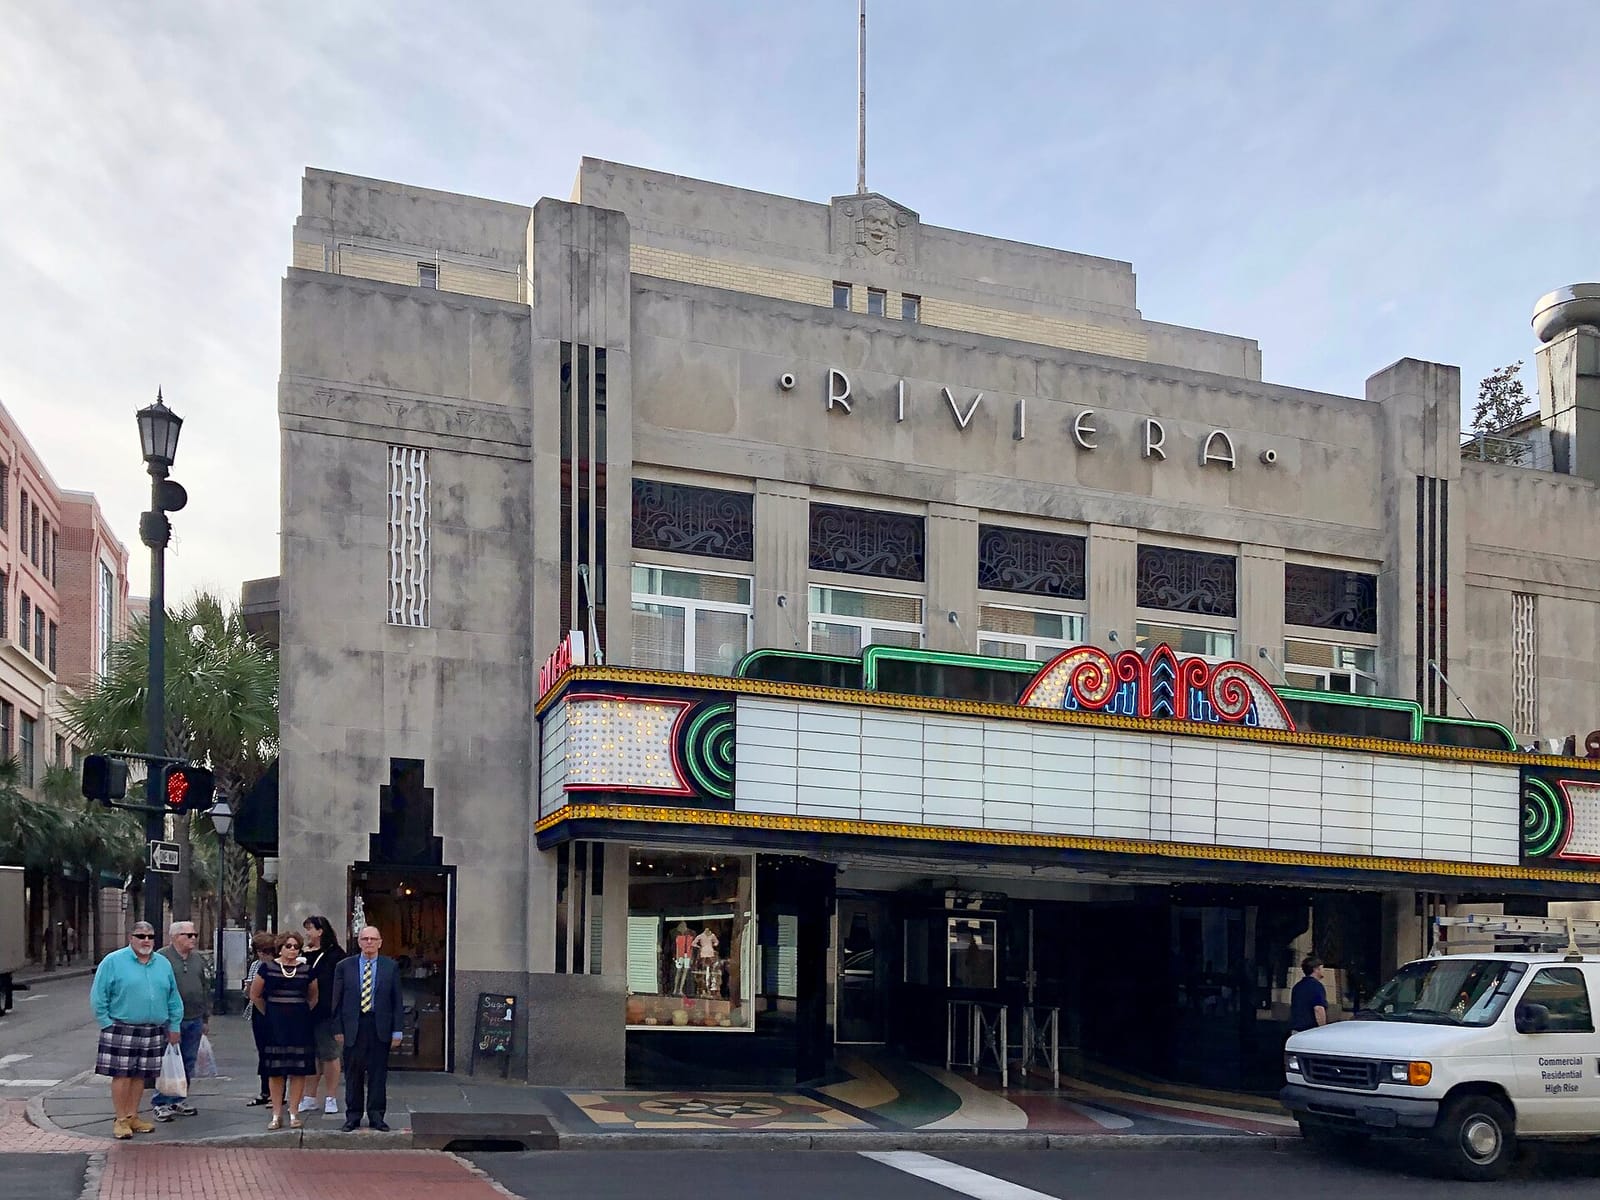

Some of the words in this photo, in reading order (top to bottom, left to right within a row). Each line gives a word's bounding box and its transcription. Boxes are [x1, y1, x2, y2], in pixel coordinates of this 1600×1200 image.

[826, 367, 1237, 471] RIVIERA
[1538, 1056, 1583, 1066] Commercial
[1541, 1070, 1583, 1080] Residential
[1545, 1083, 1562, 1095] High
[1563, 1083, 1579, 1092] Rise
